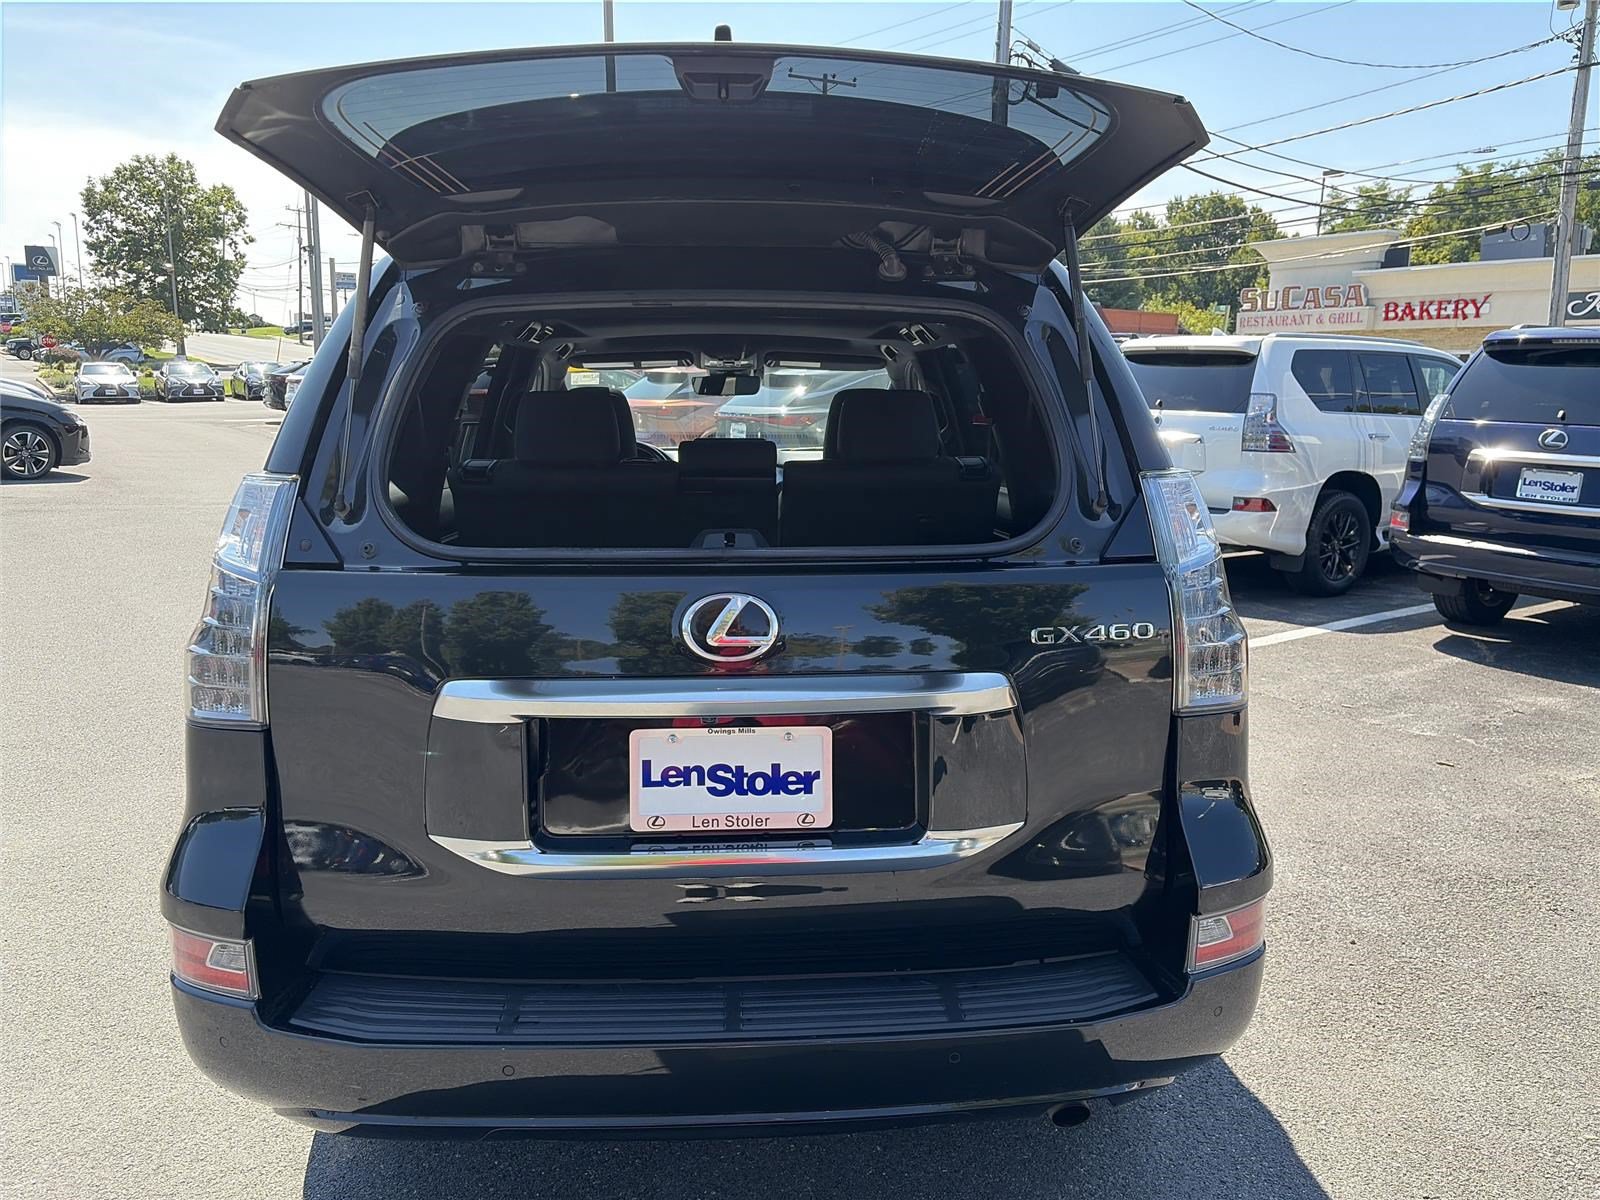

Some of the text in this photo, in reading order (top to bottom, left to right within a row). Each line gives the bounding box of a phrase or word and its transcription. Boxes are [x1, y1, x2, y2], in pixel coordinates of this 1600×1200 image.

[1382, 293, 1493, 321] BAKERY
[1239, 312, 1364, 328] RESTAURANT & GRILL
[692, 814, 770, 829] Len Stoler
